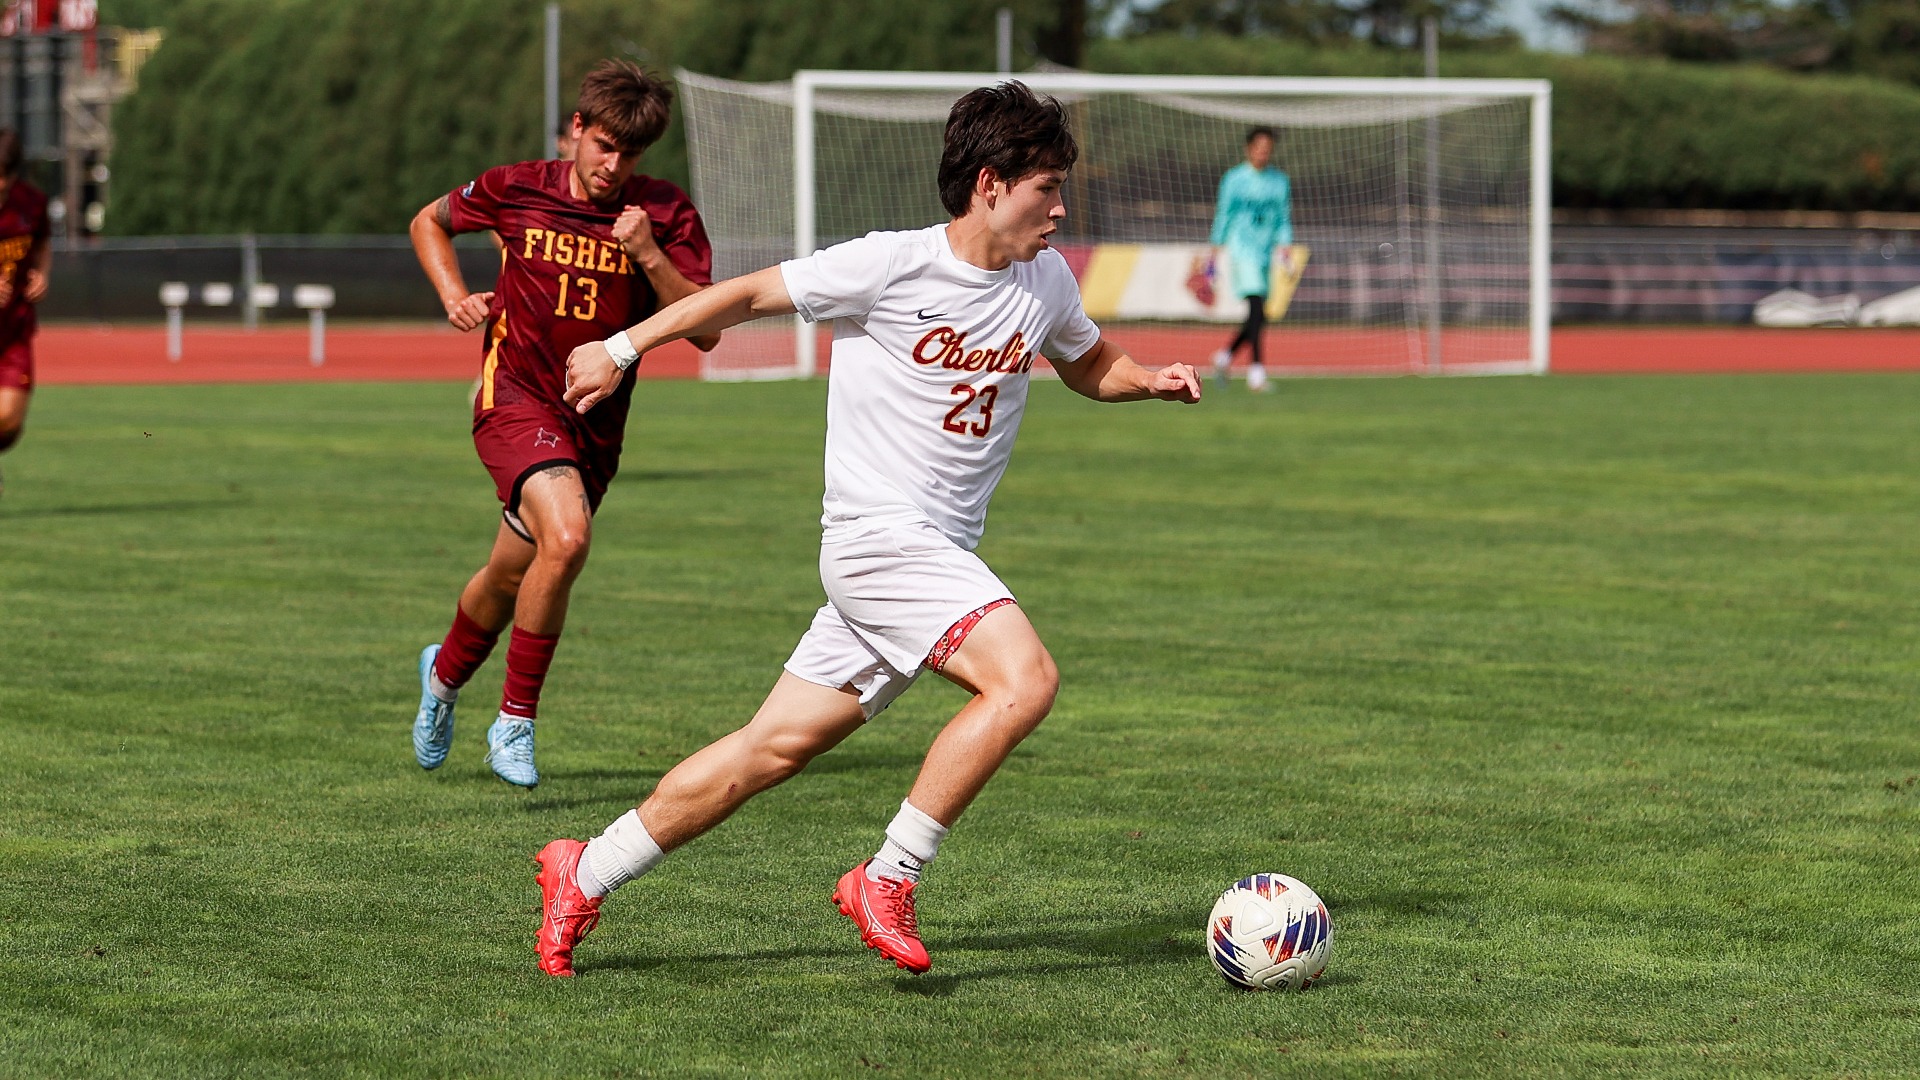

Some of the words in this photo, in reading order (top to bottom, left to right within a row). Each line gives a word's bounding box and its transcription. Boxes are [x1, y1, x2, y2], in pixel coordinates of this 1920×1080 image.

[554, 273, 598, 321] 13
[912, 326, 1033, 374] Oberlin
[943, 383, 999, 438] 23
